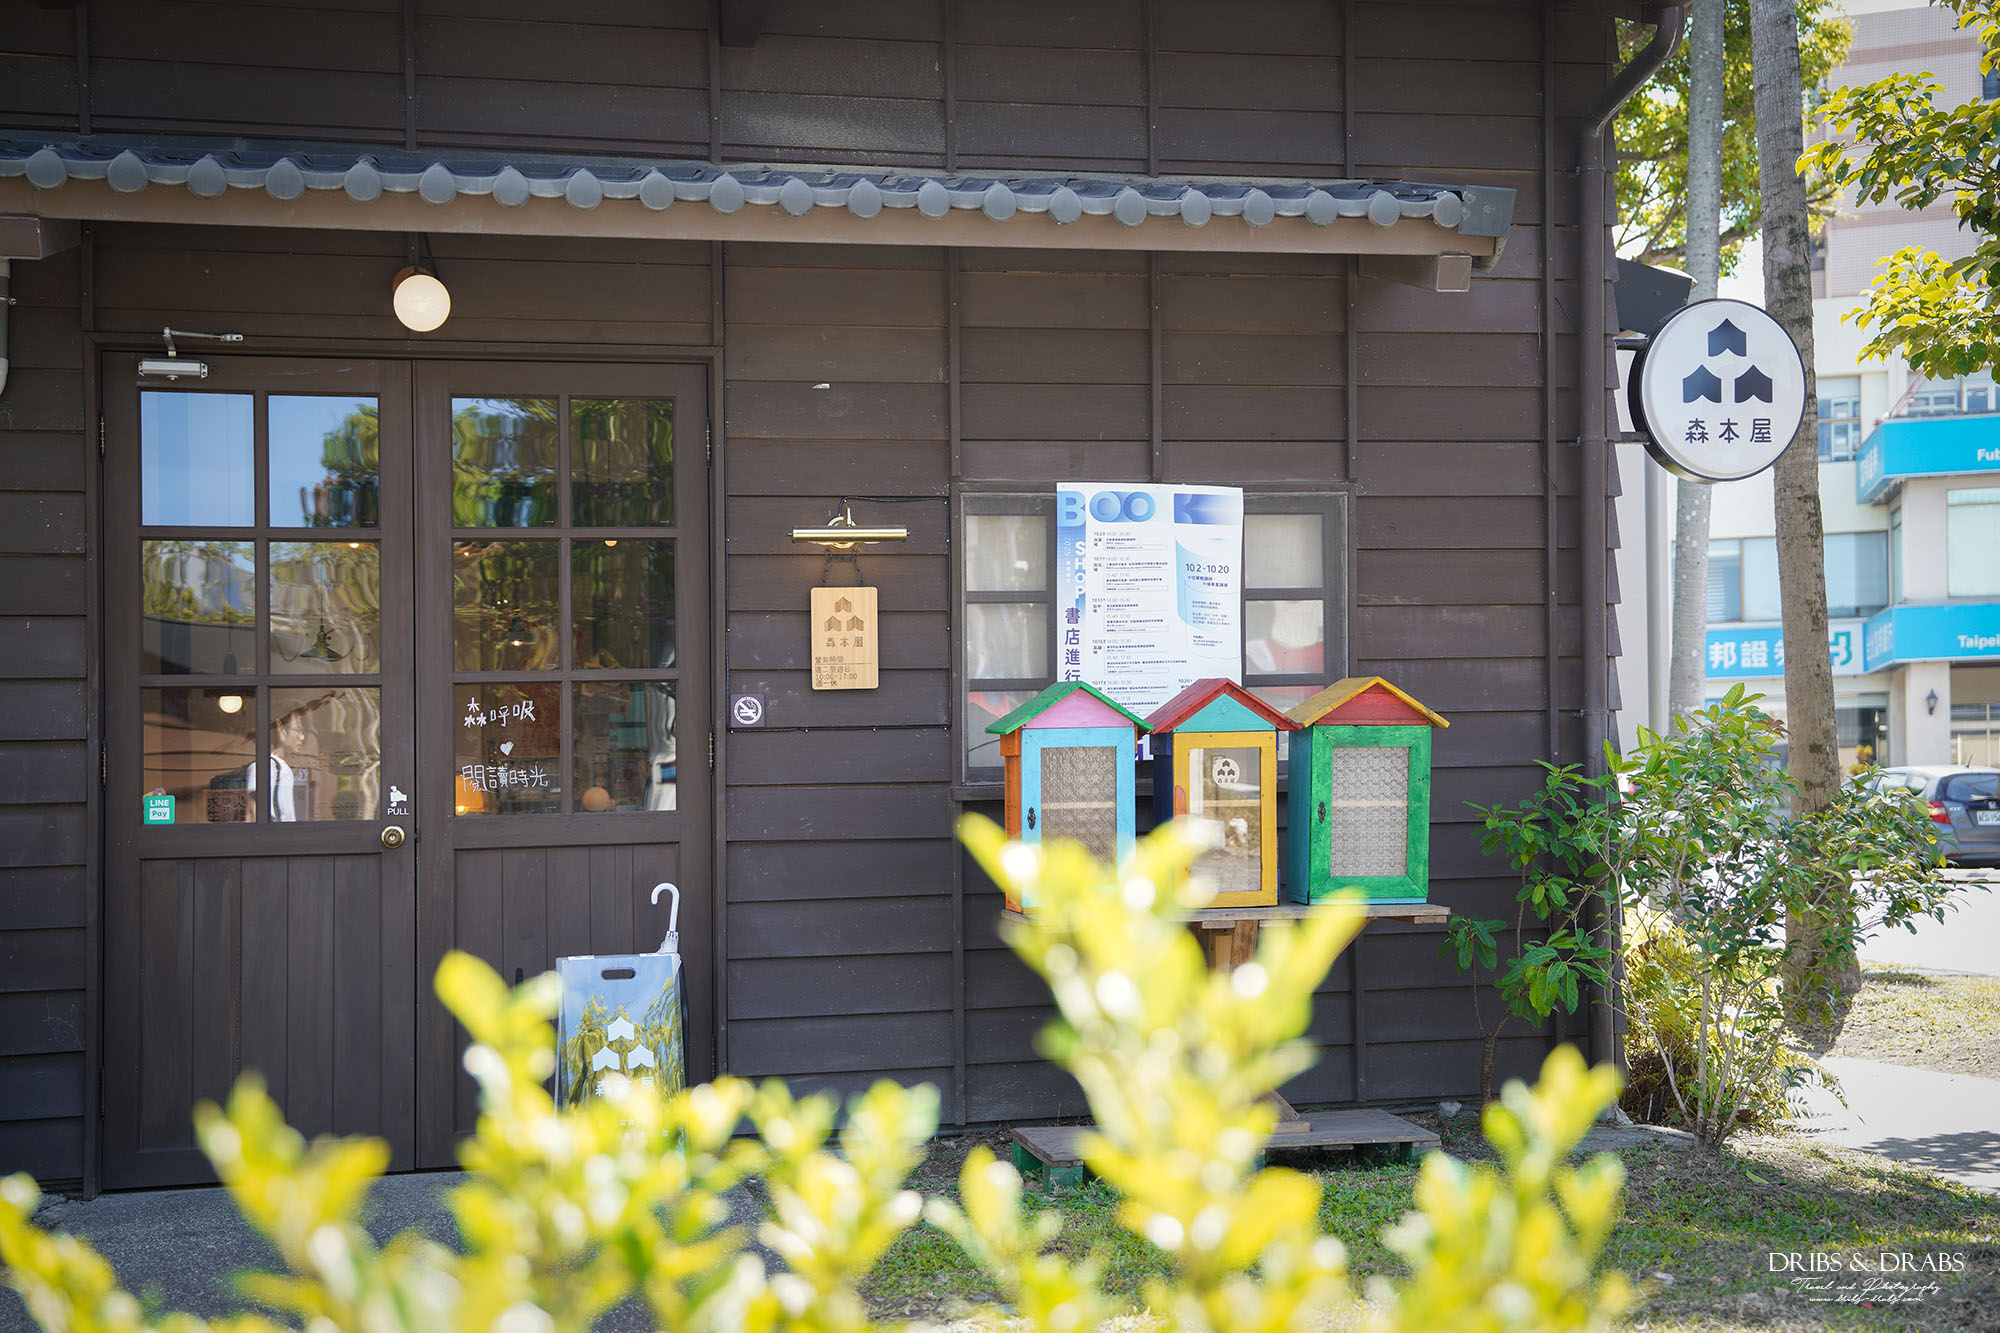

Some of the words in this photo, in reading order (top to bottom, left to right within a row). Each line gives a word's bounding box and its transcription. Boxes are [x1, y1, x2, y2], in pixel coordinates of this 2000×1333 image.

[1685, 417, 1772, 443] 森本屋
[1074, 540, 1087, 600] SHOP
[1957, 634, 2000, 650] Taipei
[464, 697, 536, 728] 森呼吸
[462, 764, 549, 793] 閱讀時光
[150, 799, 170, 807] LINE
[387, 807, 409, 816] PULL
[152, 810, 168, 819] Pay
